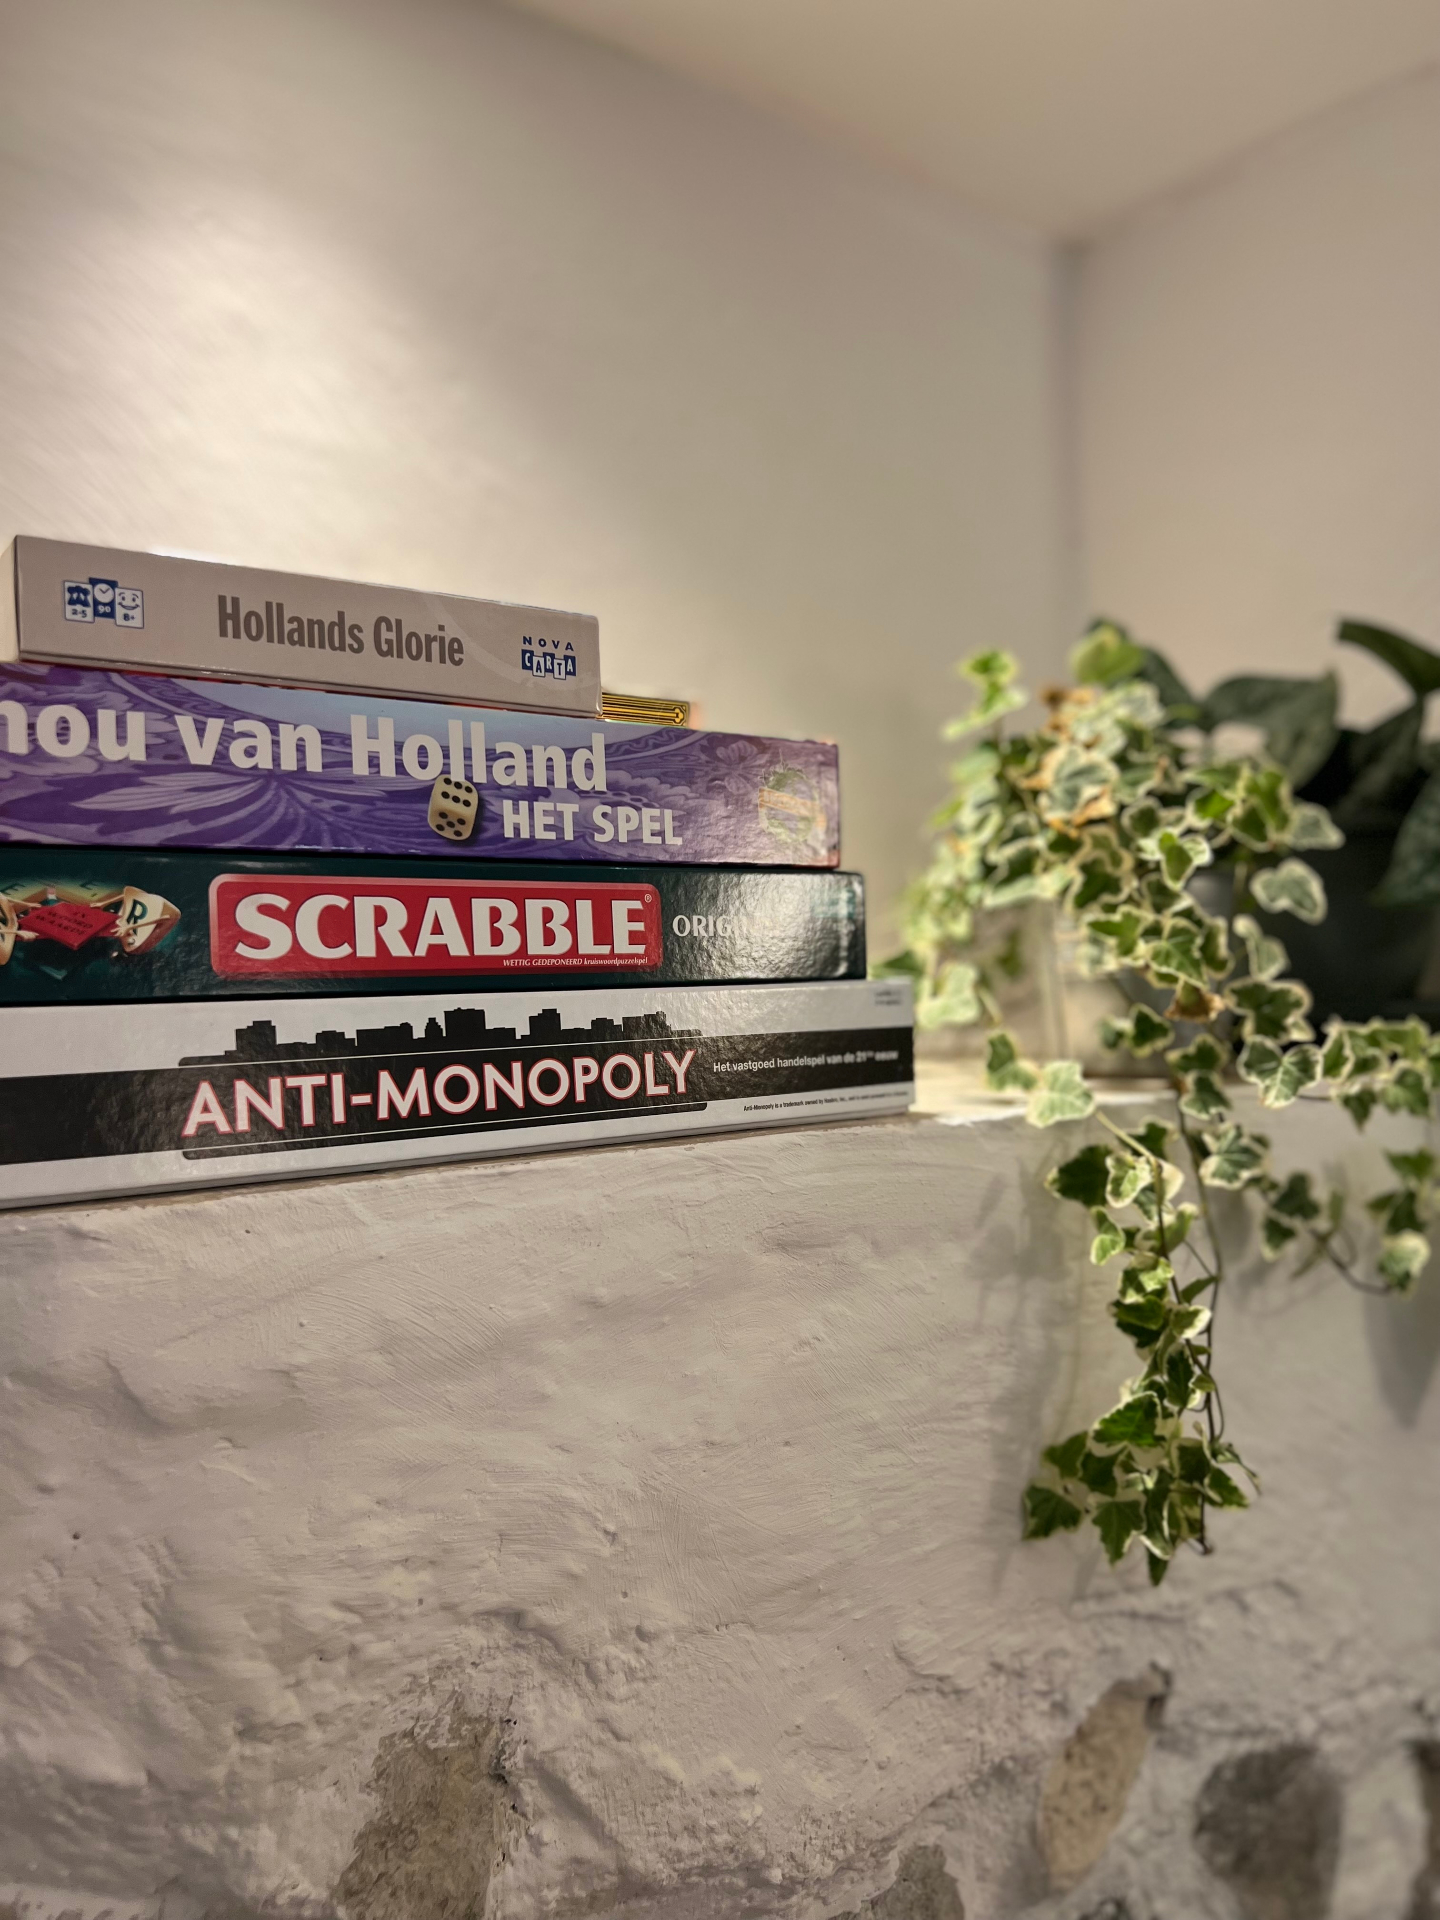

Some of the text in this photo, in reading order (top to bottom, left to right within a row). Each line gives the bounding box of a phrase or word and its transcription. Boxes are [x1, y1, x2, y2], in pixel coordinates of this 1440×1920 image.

[72, 609, 87, 618] 2-5
[98, 605, 111, 614] 90
[123, 613, 136, 622] 8+
[217, 594, 465, 667] Hollands Glorie
[522, 635, 575, 652] NOVA
[523, 651, 575, 676] CARTA
[174, 713, 323, 773] van
[350, 714, 608, 792] Holland
[502, 799, 683, 846] HET SPEL
[503, 959, 531, 967] WETTIG
[532, 958, 583, 967] GEDEPONEERD
[713, 1061, 731, 1073] Het
[732, 1058, 775, 1072] vastgoed
[776, 1054, 825, 1068] handelspel
[182, 1048, 697, 1138] ANTI-MONOPOLY
[744, 1102, 774, 1112] Anti-Monopoly
[783, 1099, 804, 1107] trademark
